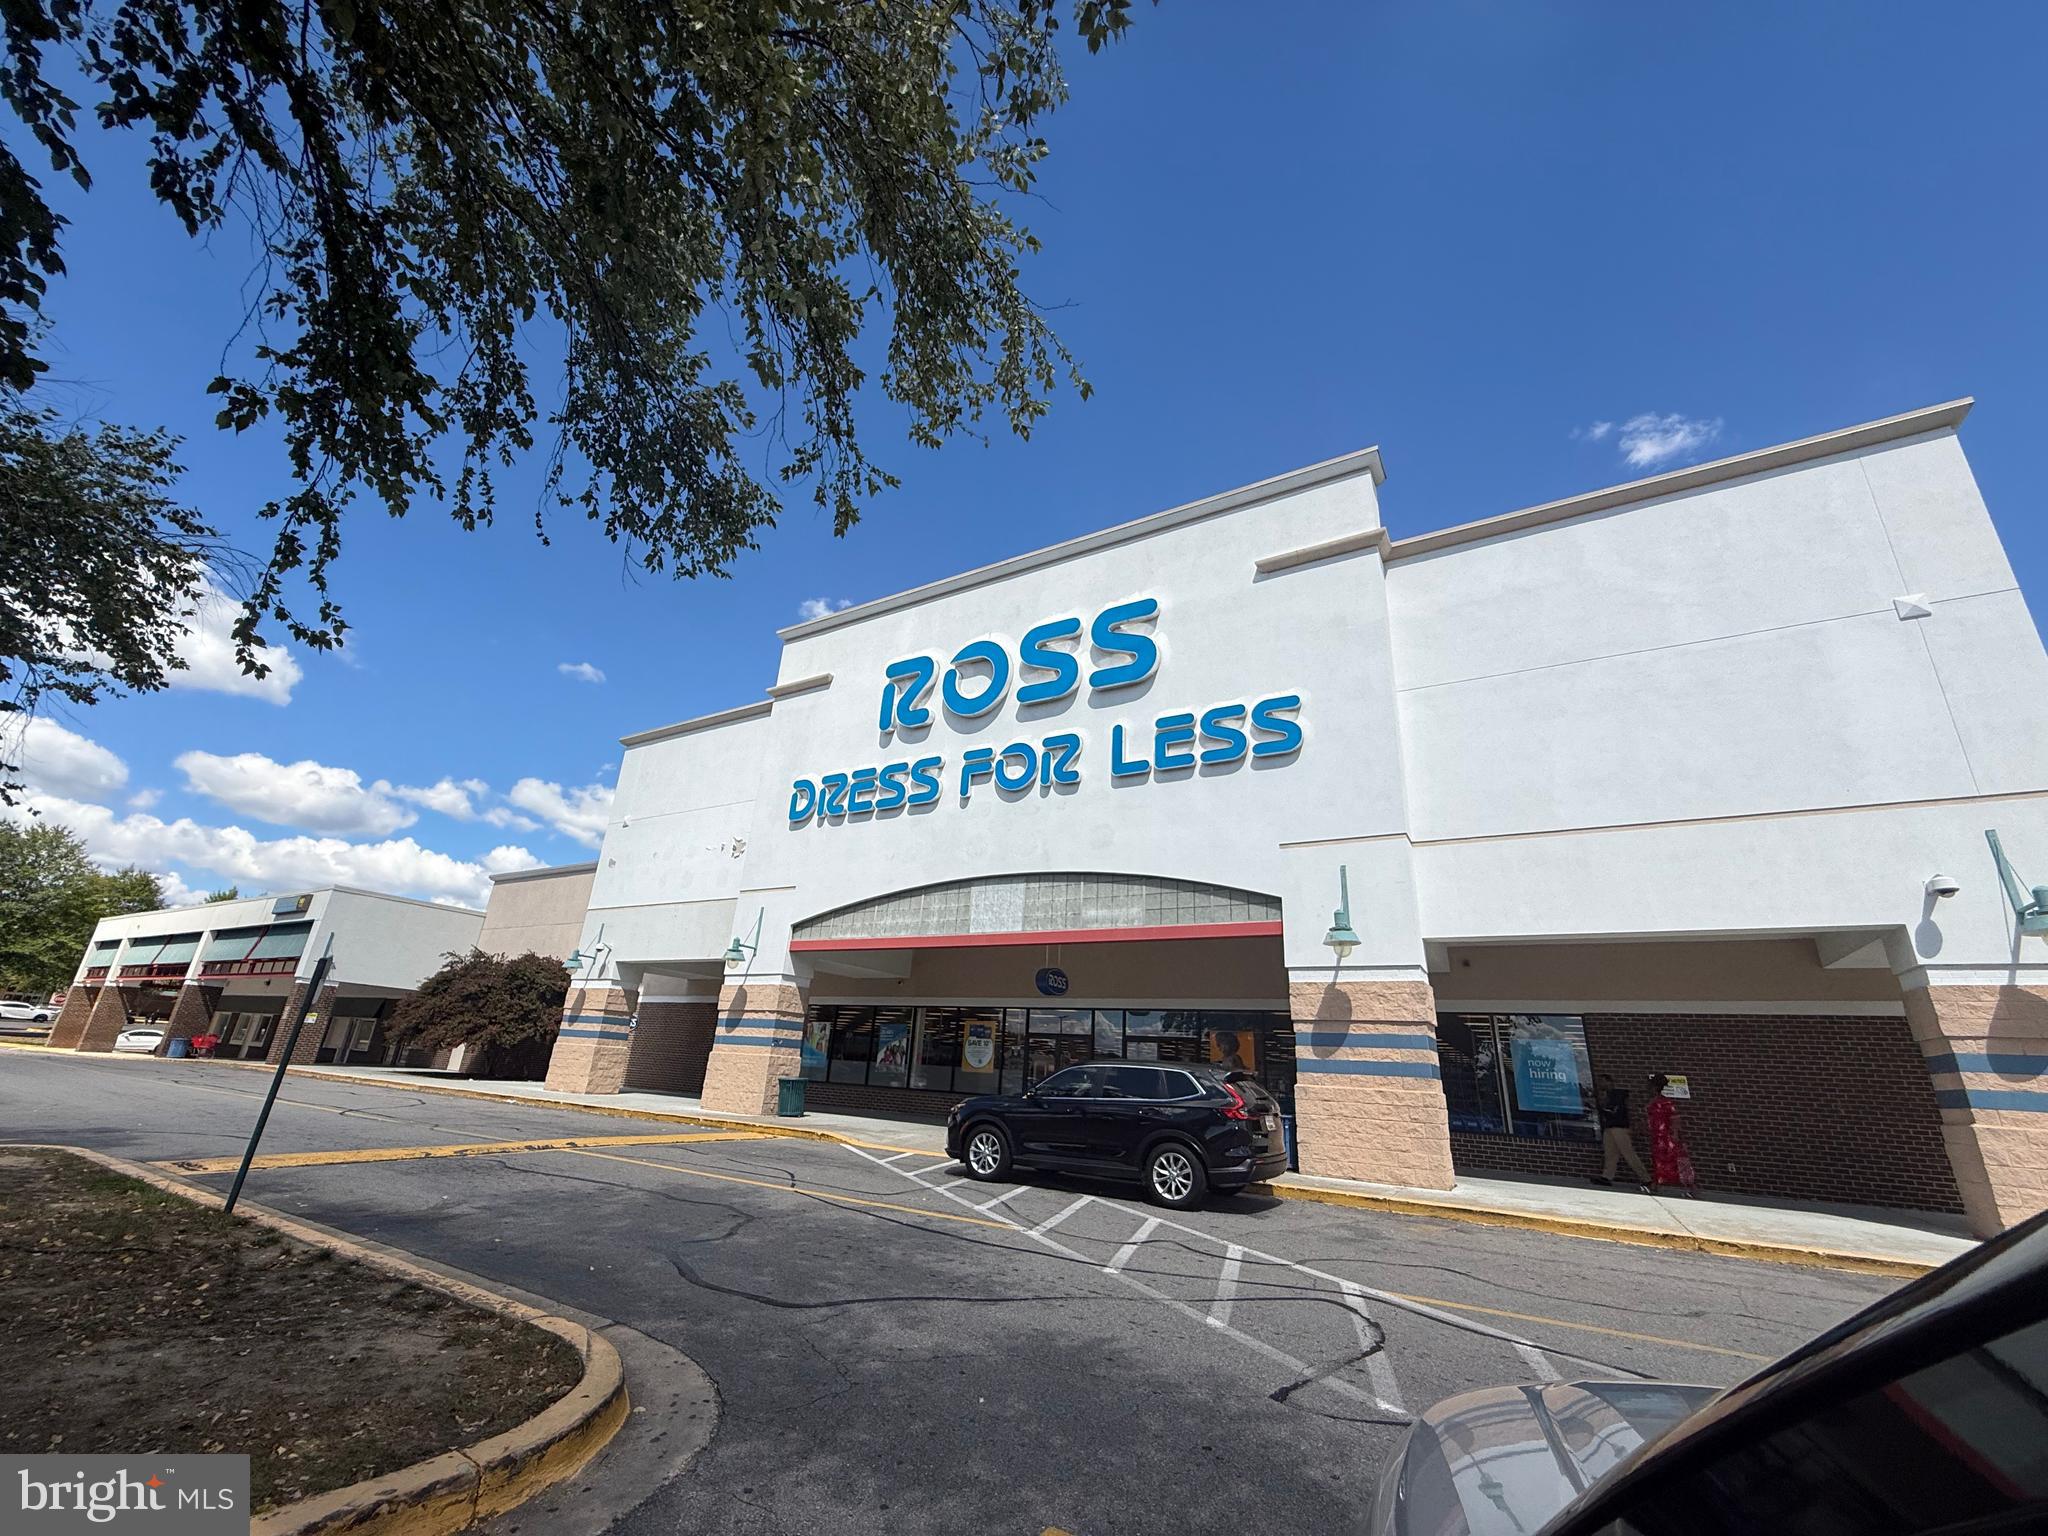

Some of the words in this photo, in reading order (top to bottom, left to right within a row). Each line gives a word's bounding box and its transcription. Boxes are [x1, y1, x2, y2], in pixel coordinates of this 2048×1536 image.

[879, 597, 1158, 732] ROSS
[789, 757, 944, 822] DRESS
[959, 734, 1081, 799] FOR
[1112, 695, 1304, 776] LESS
[1048, 974, 1067, 989] ROSS
[1527, 1059, 1551, 1068] now
[1529, 1068, 1567, 1083] hiring
